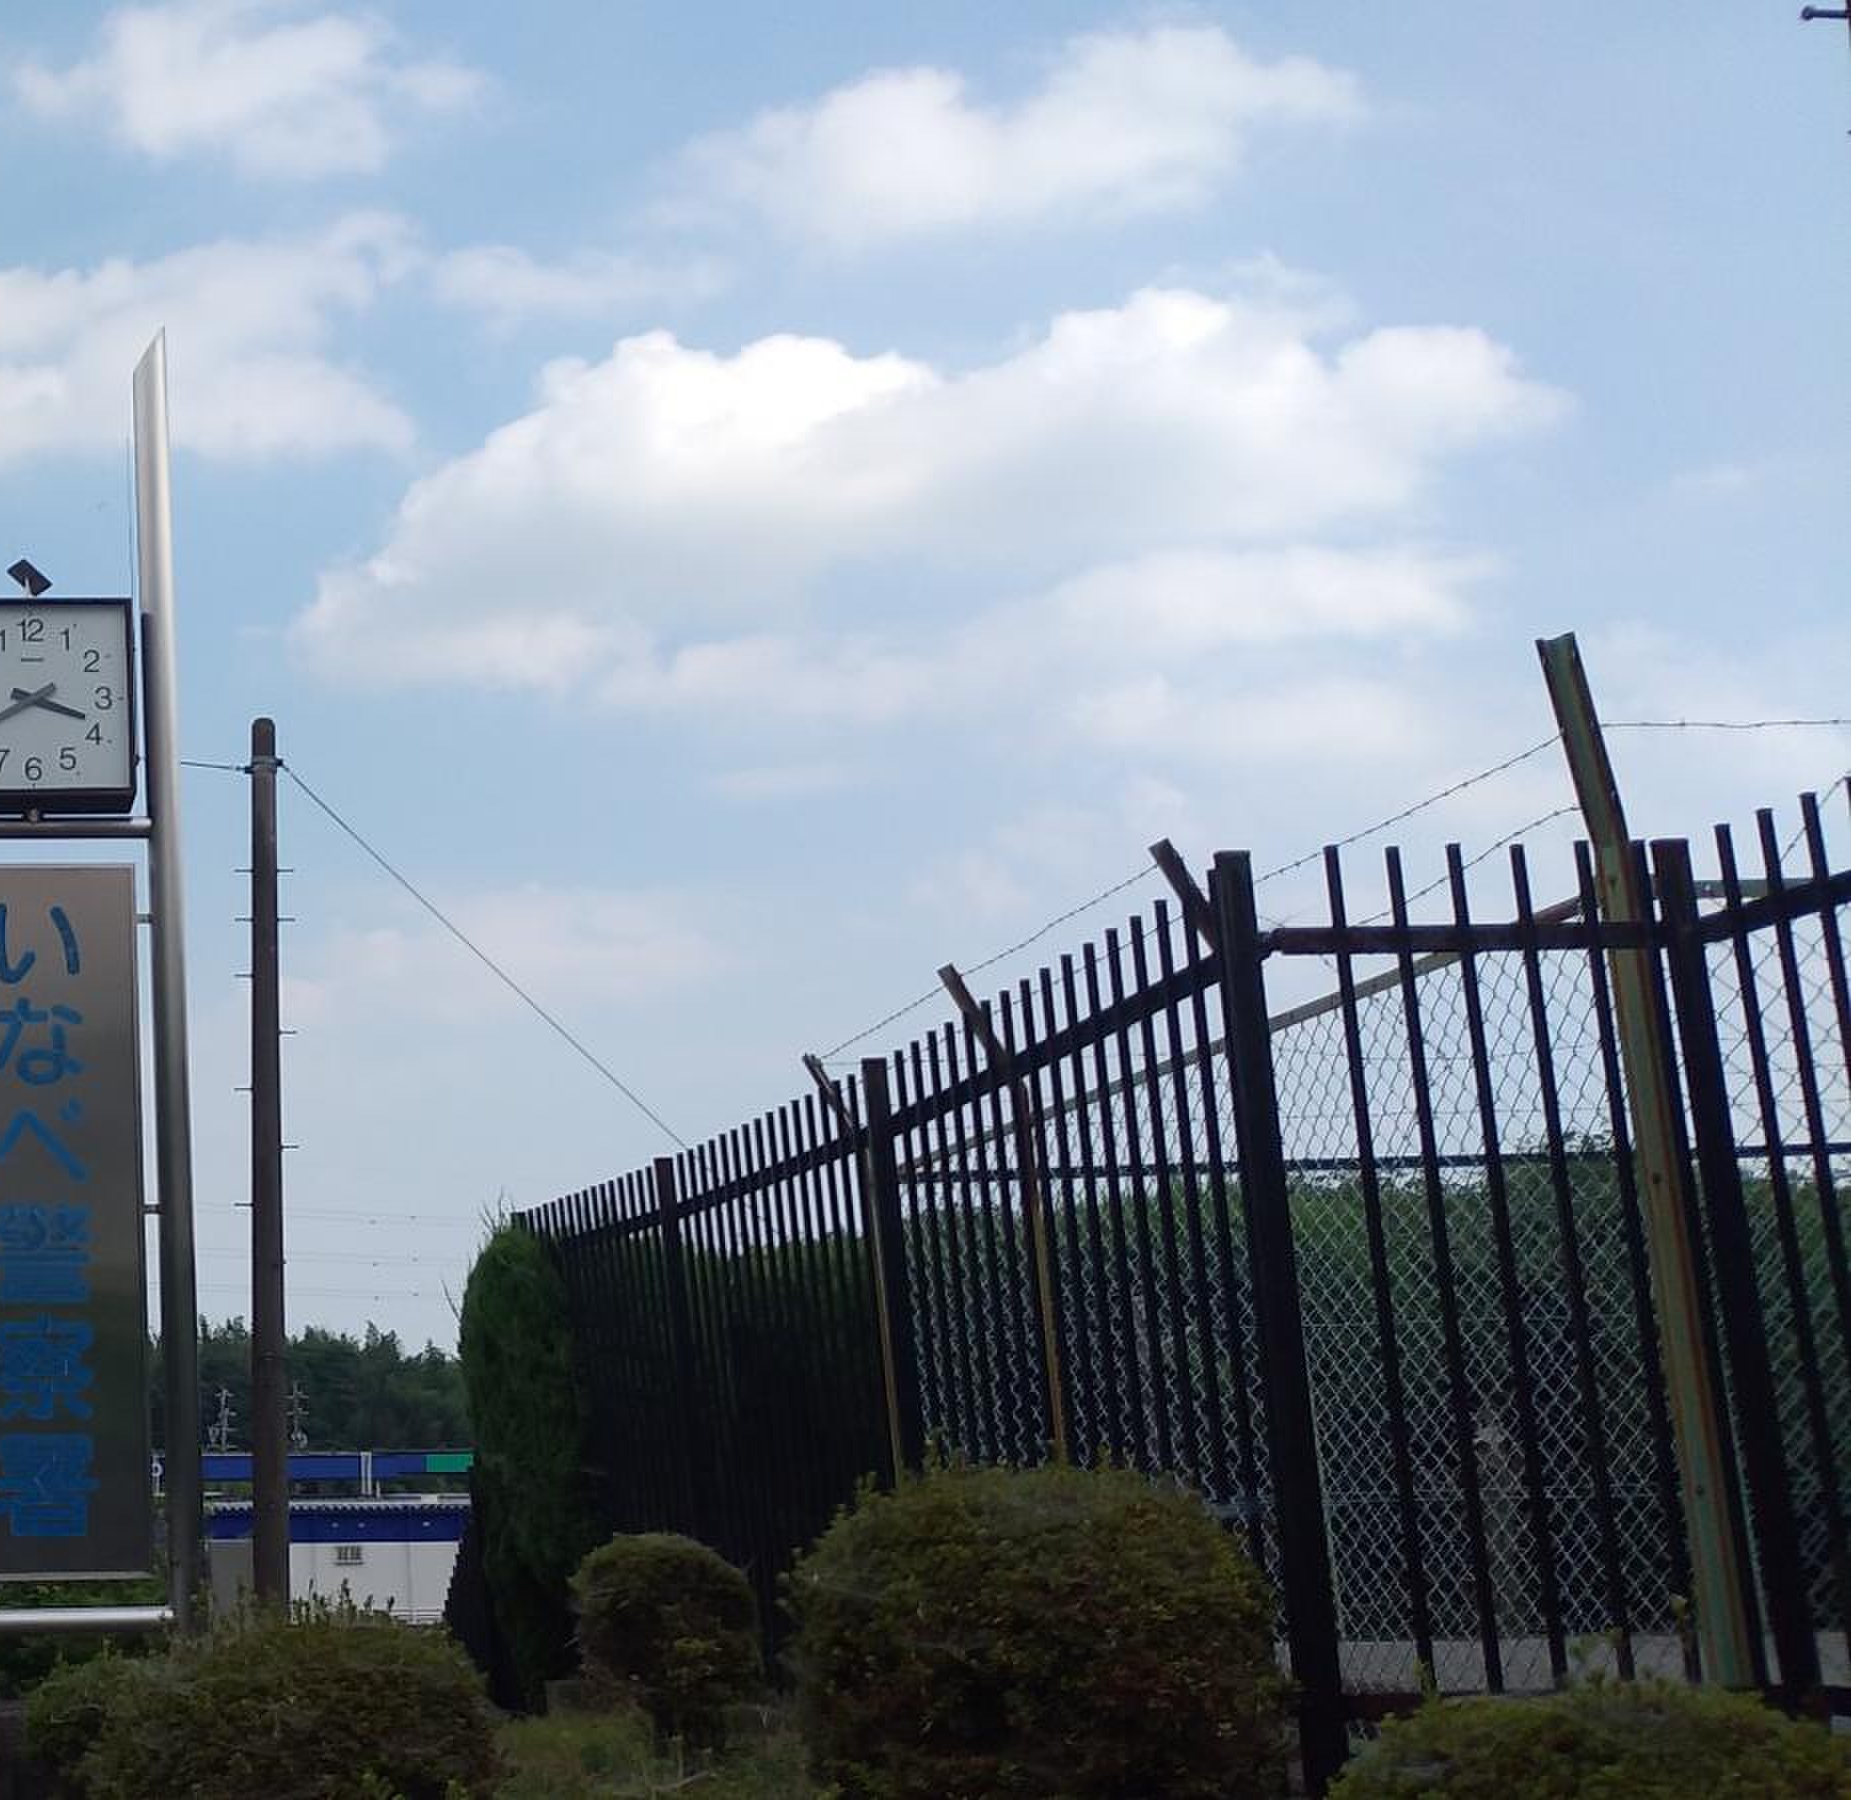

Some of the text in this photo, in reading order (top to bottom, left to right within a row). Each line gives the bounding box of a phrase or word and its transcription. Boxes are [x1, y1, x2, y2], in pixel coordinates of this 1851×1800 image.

[16, 618, 45, 642] 12
[59, 628, 71, 651] 1
[83, 649, 100, 673] 2
[94, 686, 113, 710] 3
[85, 722, 103, 745] 4
[24, 756, 42, 781] 6
[58, 747, 77, 770] 5
